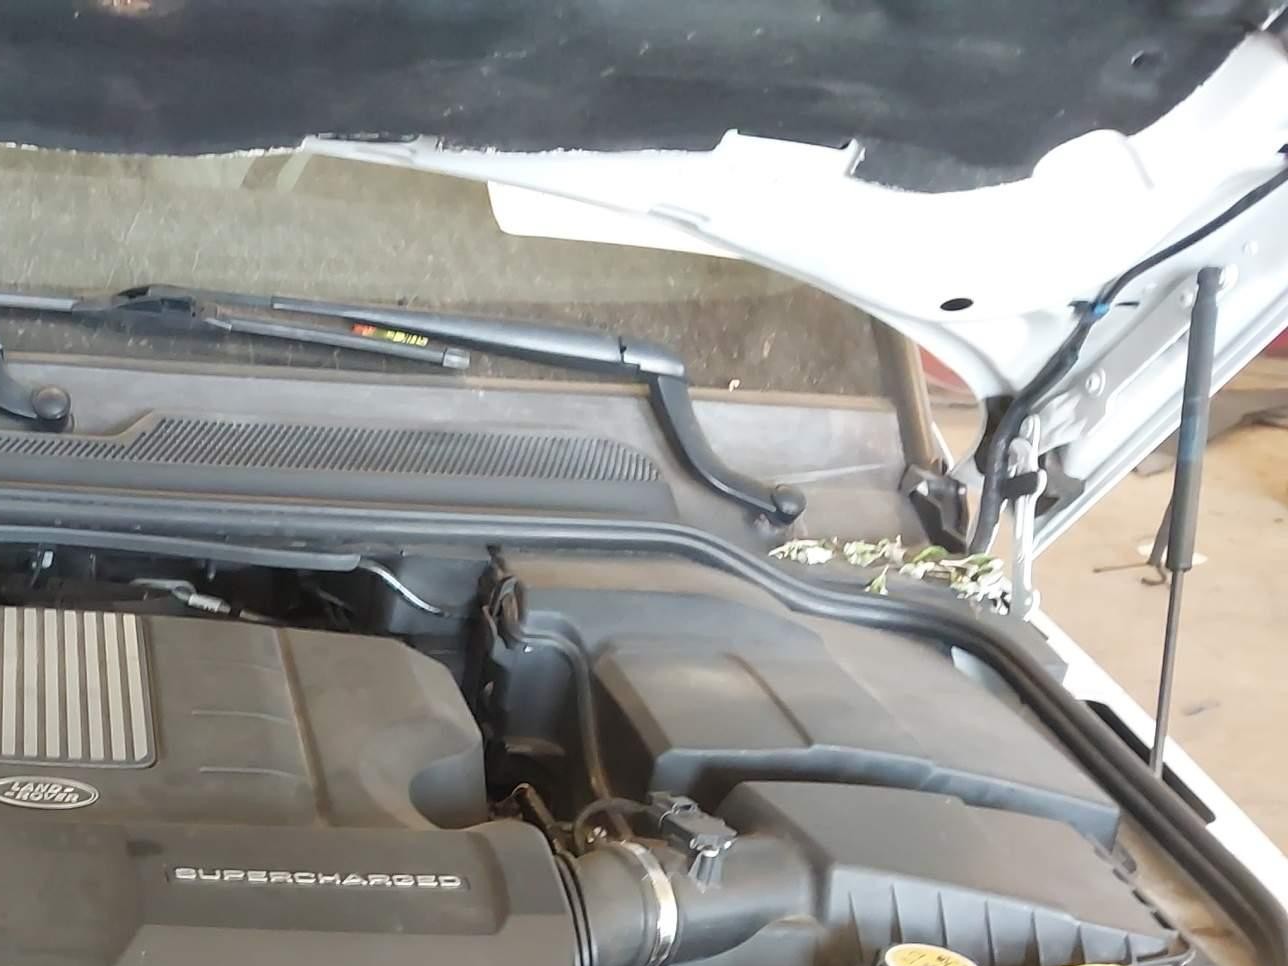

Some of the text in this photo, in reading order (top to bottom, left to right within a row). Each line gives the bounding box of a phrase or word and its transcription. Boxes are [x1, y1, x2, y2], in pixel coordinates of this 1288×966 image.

[11, 782, 62, 794] LAND
[15, 791, 79, 803] ROVER
[174, 867, 462, 888] SUPERCHARGED
